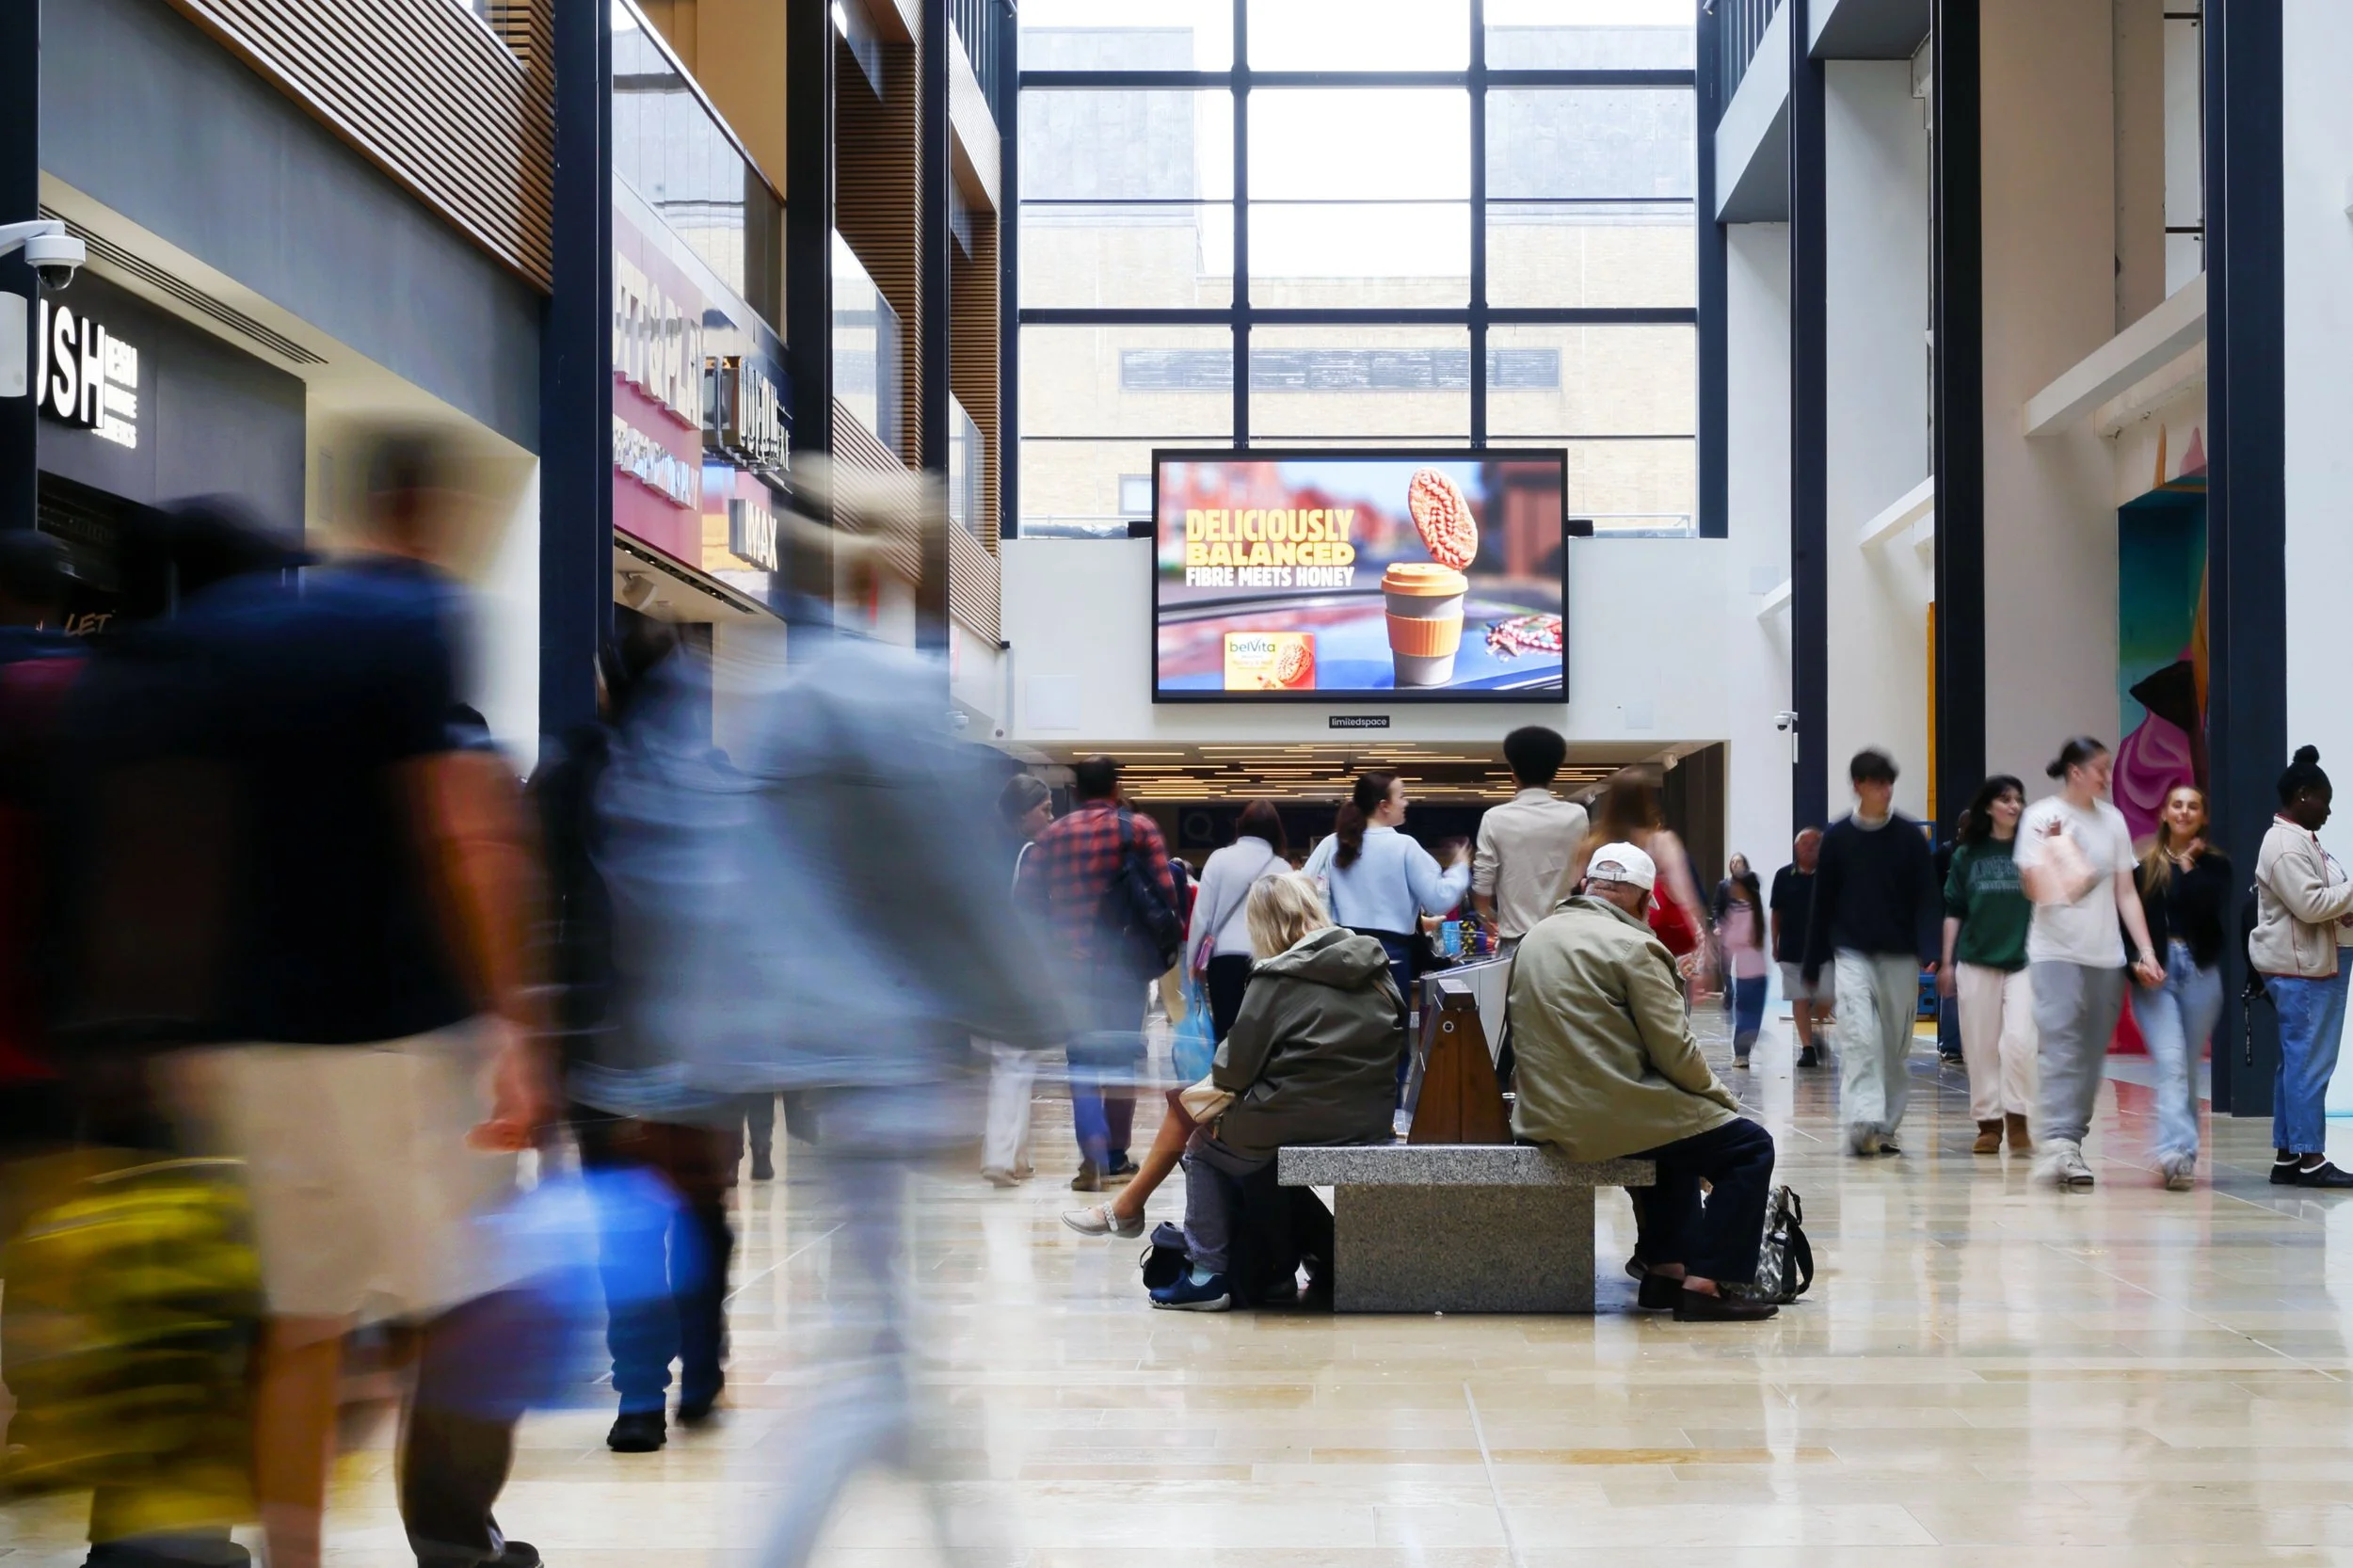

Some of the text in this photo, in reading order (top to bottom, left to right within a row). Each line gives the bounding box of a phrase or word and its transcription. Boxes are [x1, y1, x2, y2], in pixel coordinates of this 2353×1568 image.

[745, 498, 778, 572] IMAX
[1186, 509, 1355, 541] DELICIOUSLY
[1186, 542, 1355, 566] BALANCED
[1186, 567, 1355, 586] FIBRE MEETS HONEY
[1229, 638, 1275, 652] belVita
[1331, 718, 1387, 728] limitedspace
